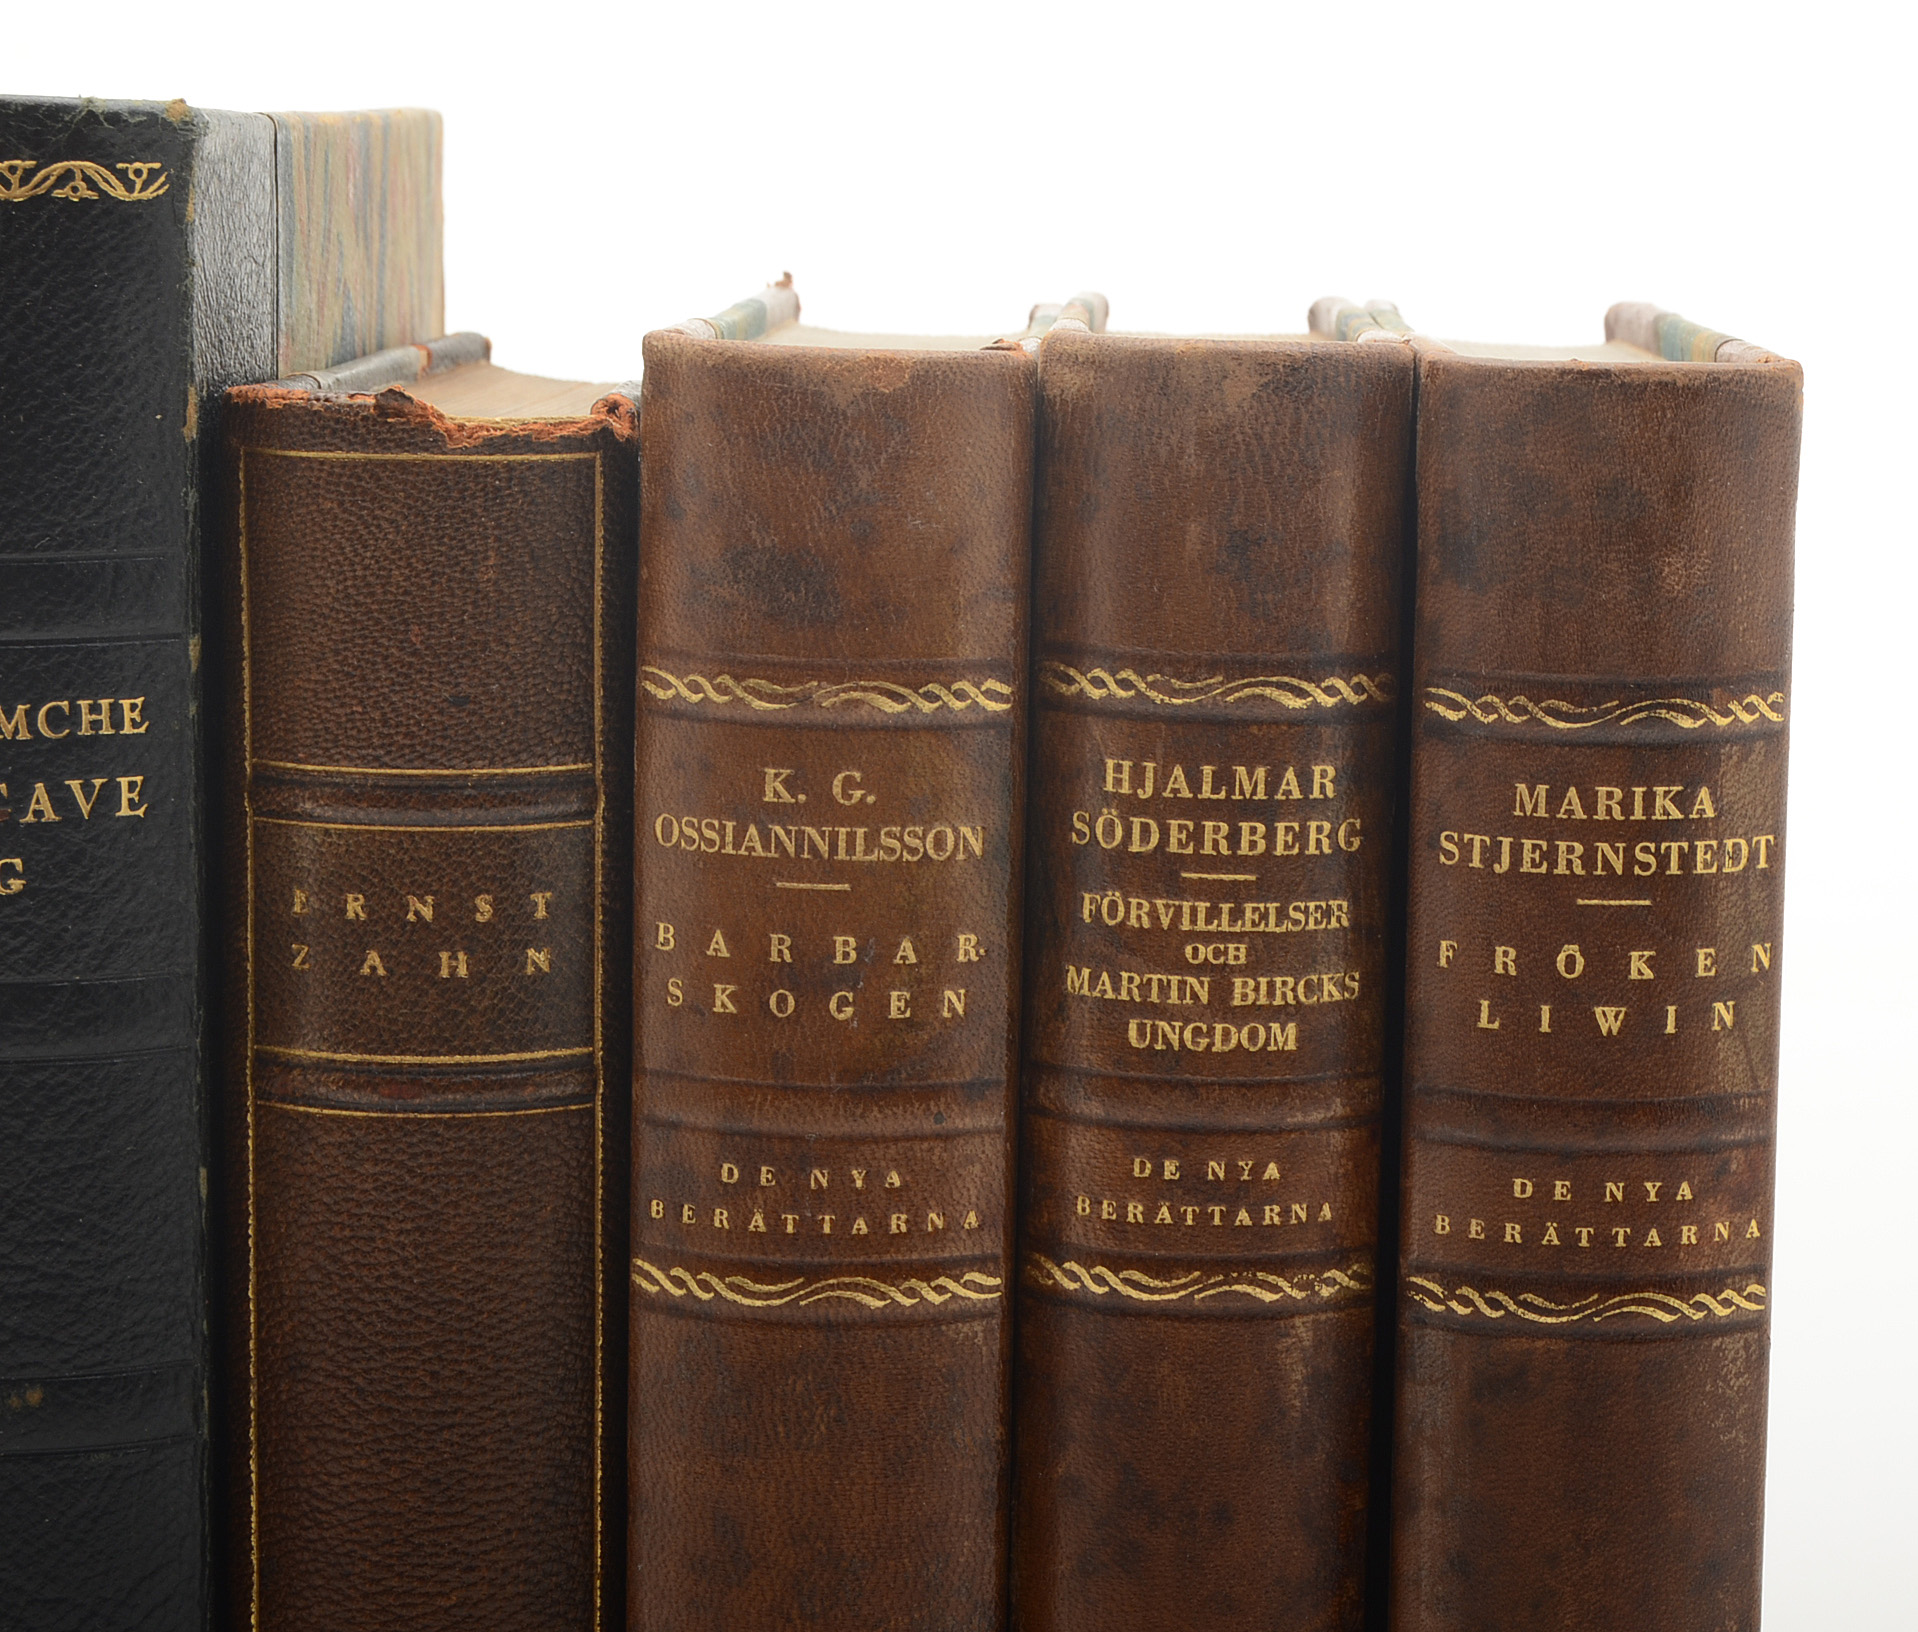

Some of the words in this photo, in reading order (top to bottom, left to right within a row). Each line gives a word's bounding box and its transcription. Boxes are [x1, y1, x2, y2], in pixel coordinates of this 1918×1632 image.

[763, 768, 807, 803] K.
[832, 771, 876, 806] G.
[1103, 758, 1337, 800] HJALMAR
[1512, 783, 1717, 820] MARIKA
[655, 813, 984, 862] OSSIANNILSSON
[1071, 808, 1363, 856] SÖDERBERG
[1439, 830, 1775, 876] STJERNSTEDT
[291, 889, 552, 922] ERNST
[1082, 891, 1350, 933] FÖRVILLELSER
[291, 943, 550, 978] ZAHN
[1184, 943, 1248, 965] OCH
[1437, 940, 1773, 980] FRÖKEN
[667, 978, 967, 1020] SKOGEN
[1065, 965, 1210, 1005] MARTIN
[1230, 971, 1360, 1007] BIRCKS
[1127, 1019, 1297, 1052] UNGDOM
[1476, 1000, 1736, 1036] LIWIN
[721, 1163, 776, 1186] DE
[810, 1169, 901, 1189] NYA
[1133, 1157, 1181, 1180] DE
[1207, 1160, 1281, 1181] NYA
[1513, 1178, 1572, 1201] DE
[1603, 1180, 1693, 1202] NYA
[650, 1200, 979, 1235] BERÄTTARNA
[1076, 1195, 1333, 1226] BERÄTTARNA
[1434, 1214, 1761, 1248] BERÄTTARNA
